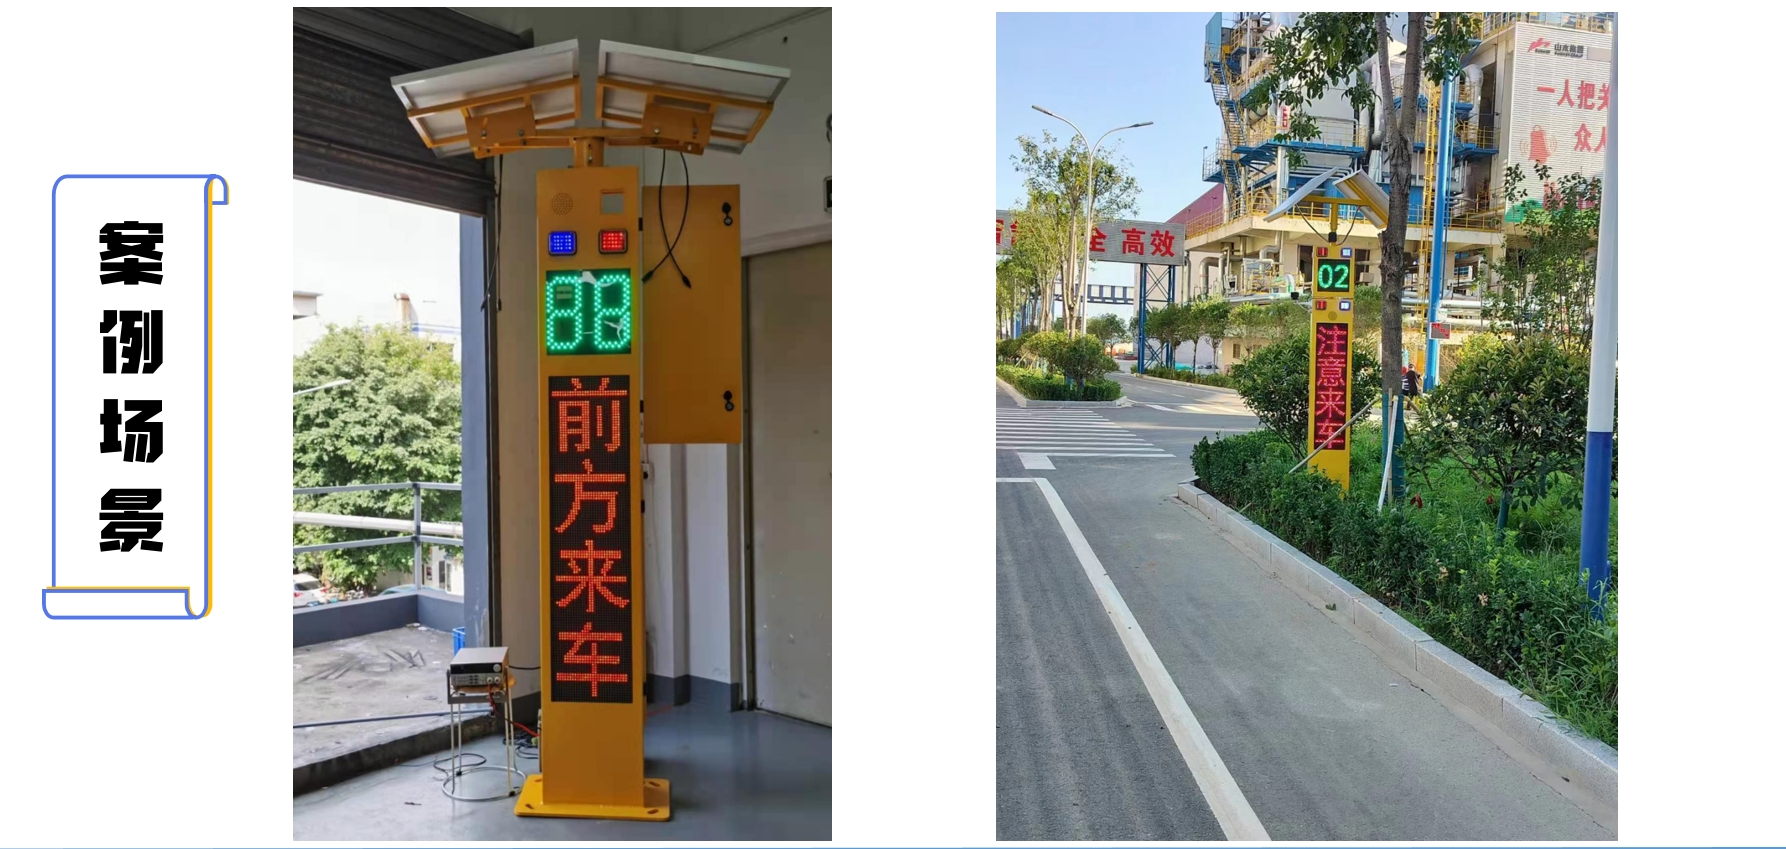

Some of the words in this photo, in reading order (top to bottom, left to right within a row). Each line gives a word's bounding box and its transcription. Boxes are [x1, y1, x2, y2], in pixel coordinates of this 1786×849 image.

[1121, 228, 1176, 258] 高效
[1318, 264, 1349, 289] 02
[546, 275, 631, 350] 88
[1315, 325, 1347, 449] 注意来车
[551, 377, 630, 697] 前方来车
